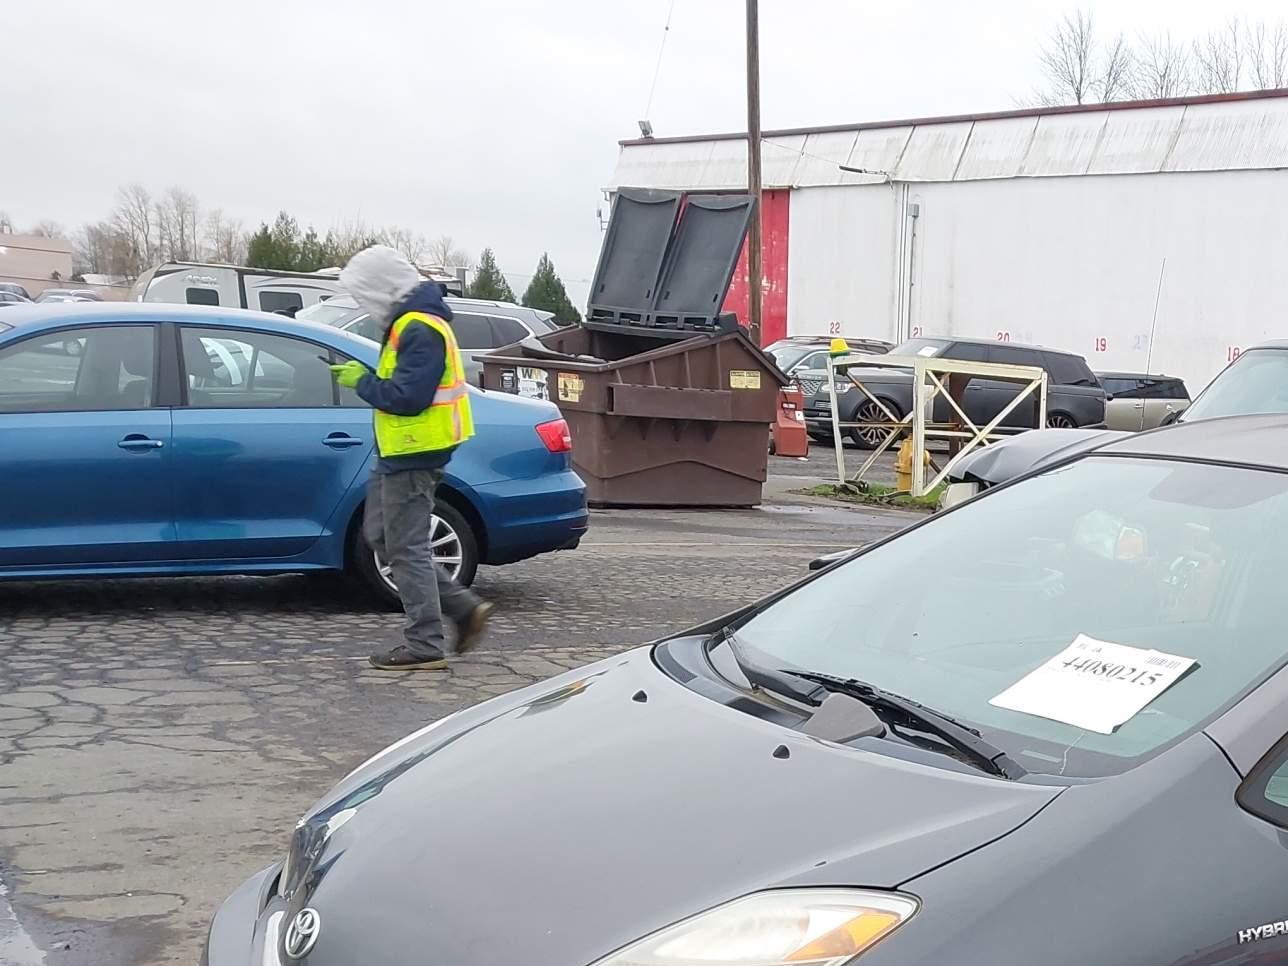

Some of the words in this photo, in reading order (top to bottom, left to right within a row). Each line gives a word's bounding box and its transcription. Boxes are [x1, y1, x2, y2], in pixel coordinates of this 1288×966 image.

[829, 321, 841, 334] 22
[913, 327, 923, 337] 21
[1094, 337, 1107, 352] 19
[1062, 655, 1164, 687] 44080215
